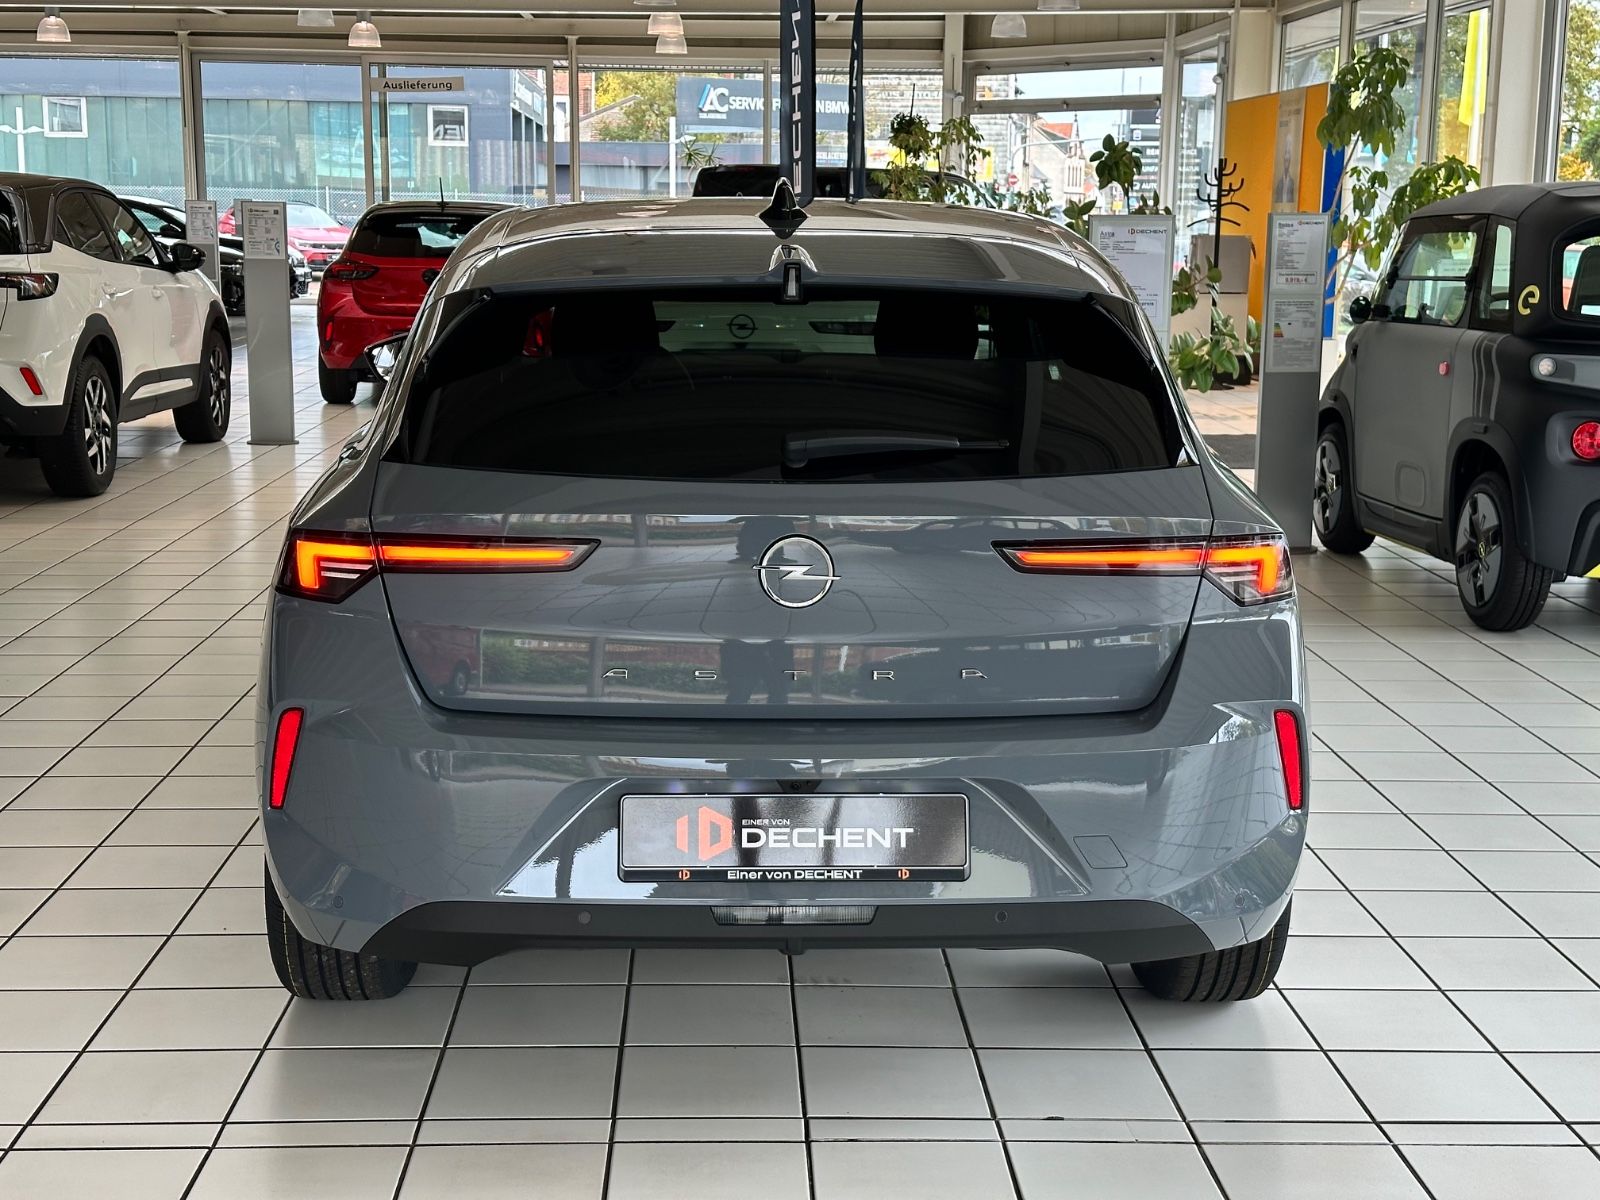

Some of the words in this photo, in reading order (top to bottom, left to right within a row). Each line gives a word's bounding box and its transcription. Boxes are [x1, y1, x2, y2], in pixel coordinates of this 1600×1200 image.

[383, 80, 453, 91] Auslieferung
[729, 96, 764, 111] SERVIC
[602, 668, 988, 681] ASTRA
[741, 827, 914, 848] DECHENT
[727, 870, 763, 879] Einer
[794, 870, 863, 879] DECHENT
